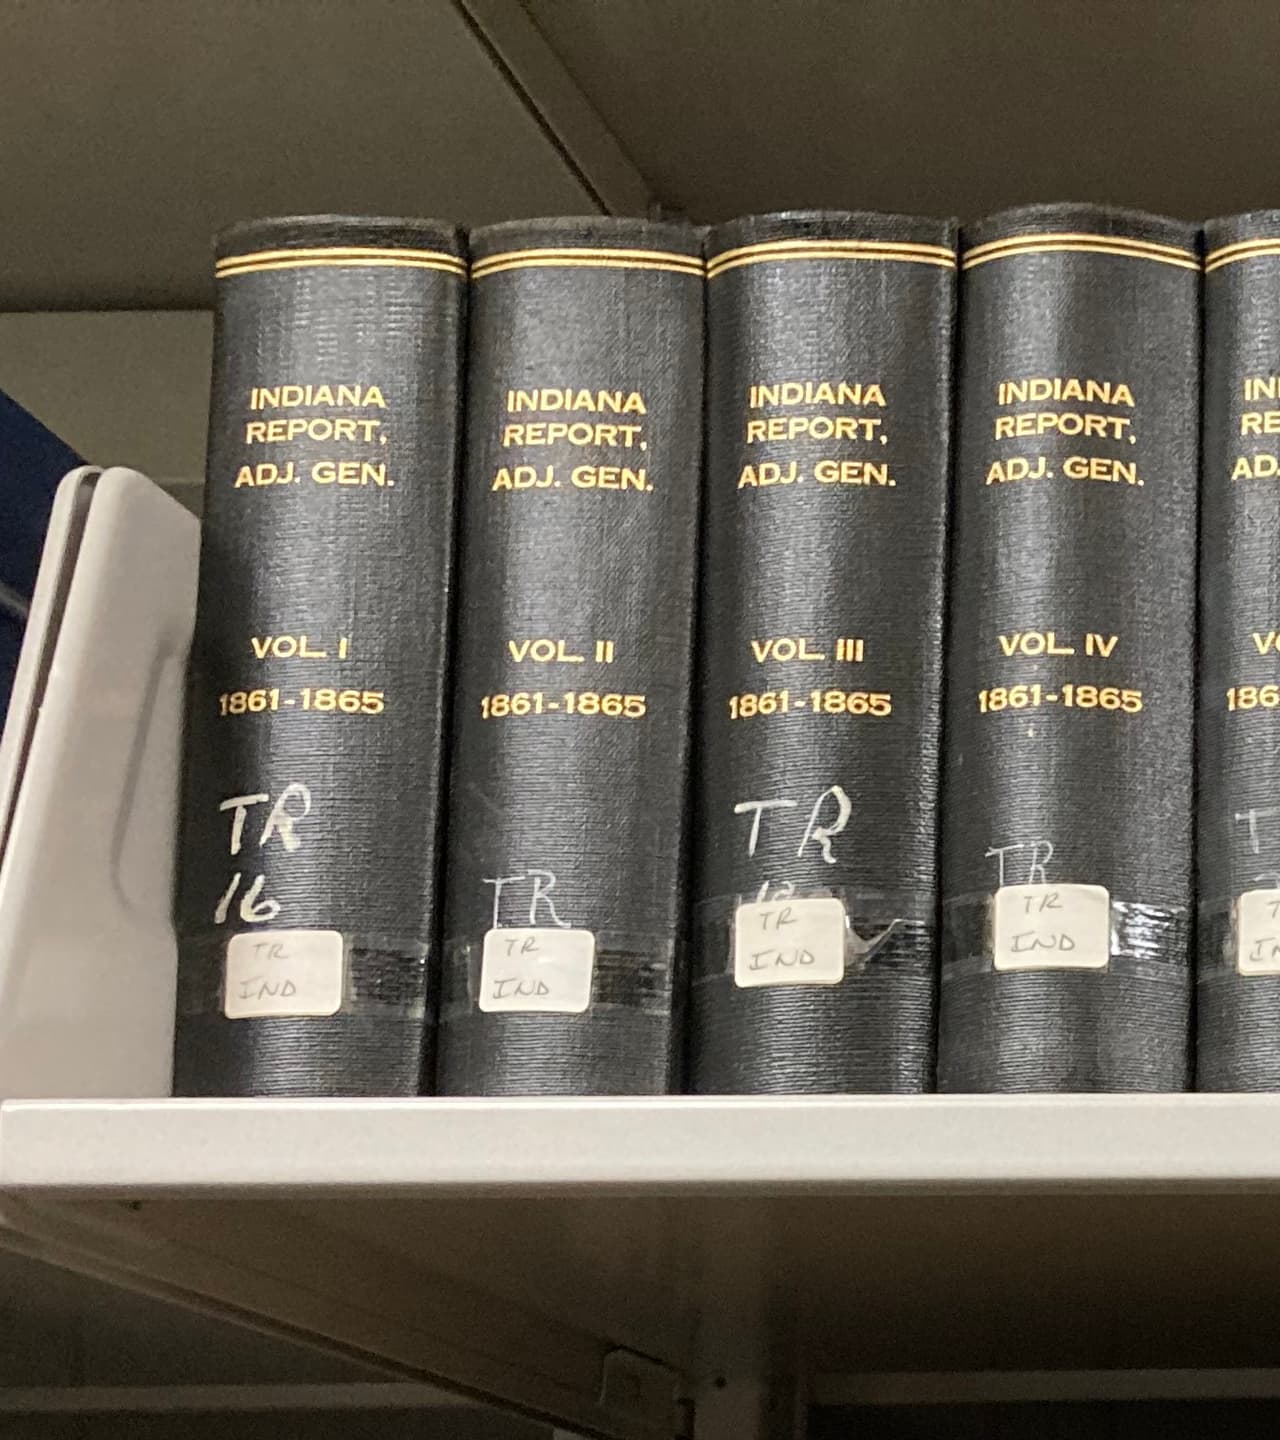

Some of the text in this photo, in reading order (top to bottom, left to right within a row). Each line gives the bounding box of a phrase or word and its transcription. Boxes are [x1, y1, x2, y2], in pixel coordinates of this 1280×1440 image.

[250, 386, 386, 410] INDIANA
[246, 419, 387, 444] REPORT,
[234, 462, 394, 489] ADJ. GEN.
[339, 637, 349, 659] I
[219, 690, 384, 715] 1861-1865
[219, 784, 312, 856] TR
[213, 872, 280, 923] 16
[253, 941, 289, 960] TR
[238, 980, 297, 999] IND
